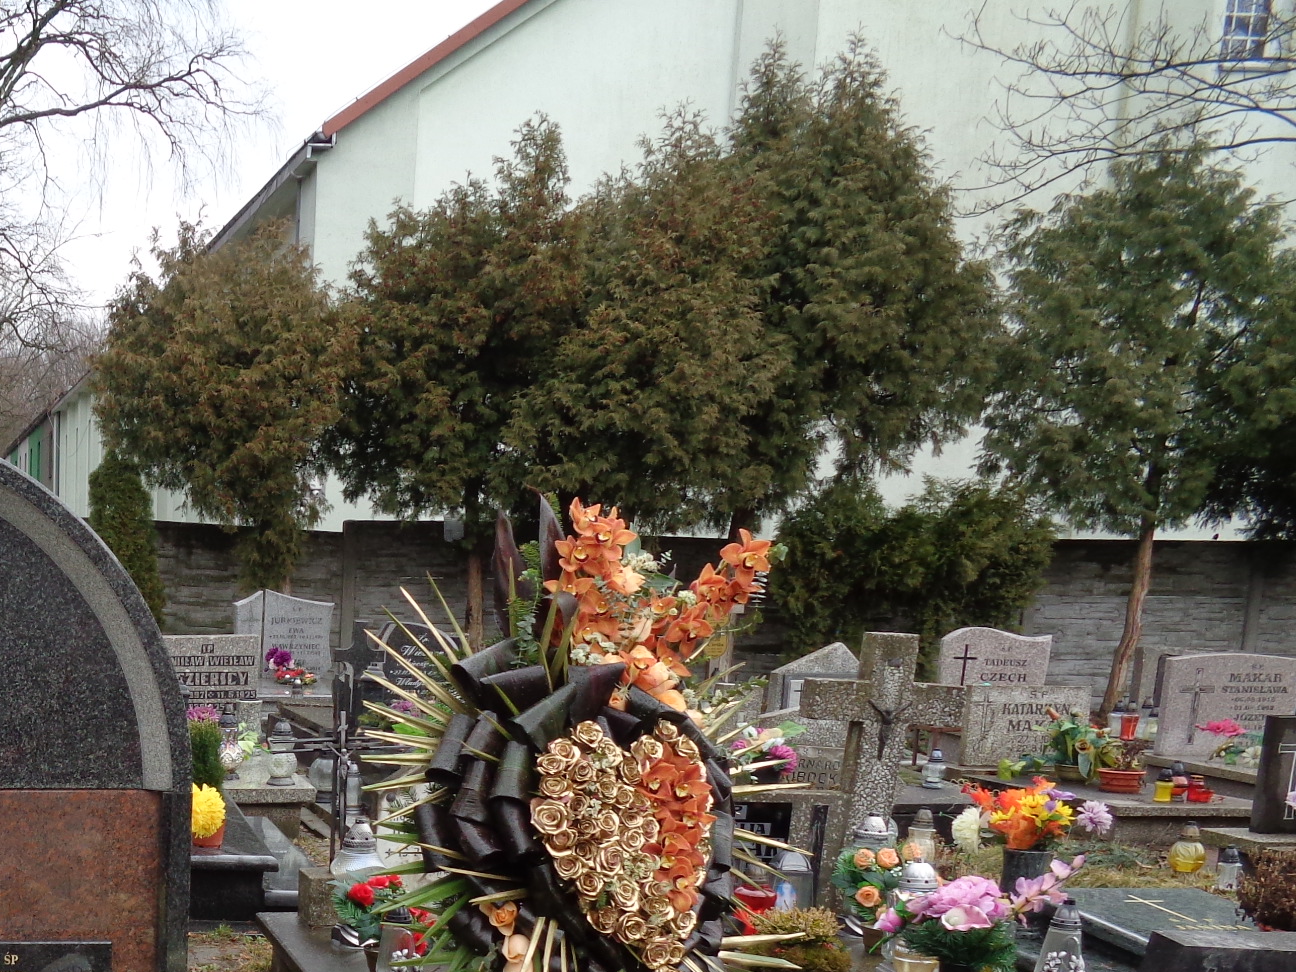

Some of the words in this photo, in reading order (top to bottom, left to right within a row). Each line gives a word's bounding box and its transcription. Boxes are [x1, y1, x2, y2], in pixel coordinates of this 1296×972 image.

[984, 658, 1029, 667] TADEUSZ
[980, 672, 1027, 683] CZECH
[1228, 673, 1283, 683] MAKAR
